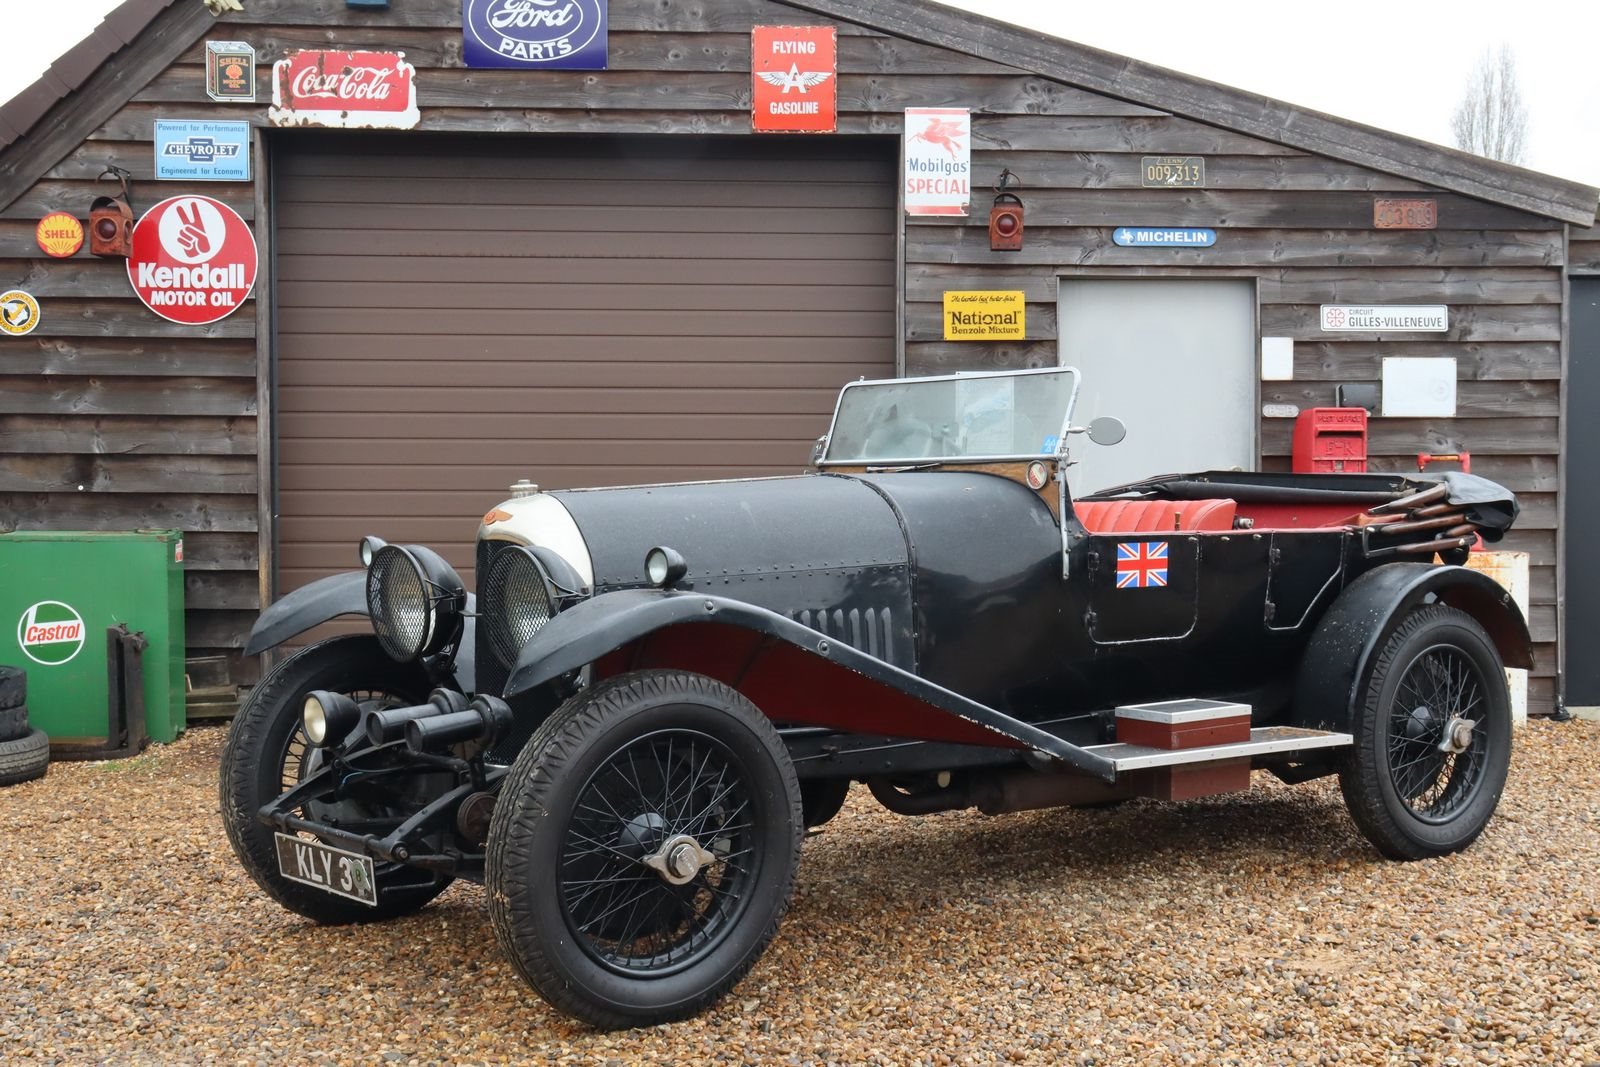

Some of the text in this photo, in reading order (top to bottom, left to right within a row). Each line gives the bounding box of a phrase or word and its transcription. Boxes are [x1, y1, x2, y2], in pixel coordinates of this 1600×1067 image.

[491, 0, 574, 28] Ford
[499, 38, 572, 59] PARTS
[772, 40, 816, 54] FLYING
[219, 57, 248, 67] SHELL
[292, 65, 396, 99] Coca-Cola
[769, 101, 819, 115] GASOLINE
[158, 123, 245, 132] Powered for Performance
[168, 144, 235, 155] CHEVROLET
[161, 167, 243, 176] Engineered for Economy
[907, 178, 969, 194] SPECIAL
[45, 229, 77, 239] SHELL
[1137, 231, 1207, 242] MICHELIN
[138, 262, 245, 289] Kendall
[150, 290, 235, 307] MOTOR OIL
[1348, 308, 1374, 316] CIRCUIT
[1348, 317, 1443, 328] GILLES-VILLENEUVE
[951, 326, 1020, 334] Benzole Mixture
[26, 623, 81, 643] Castrol
[295, 843, 332, 886] KLY
